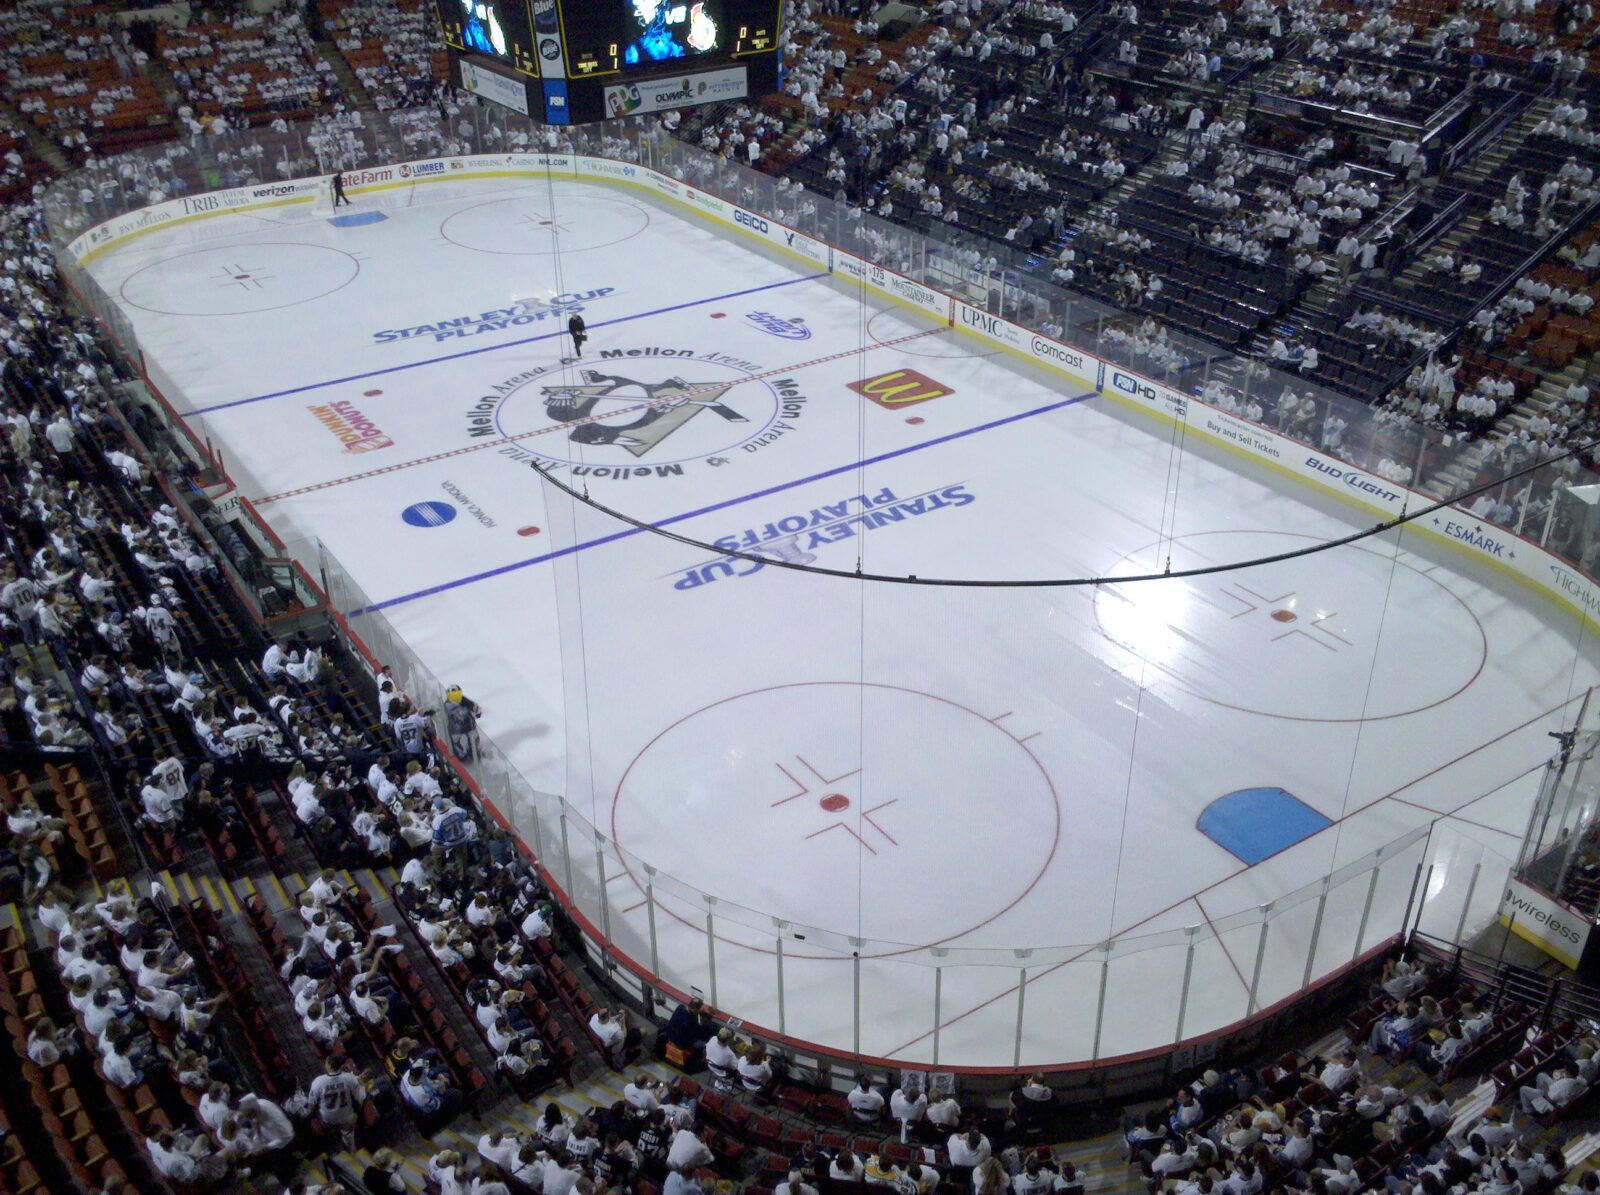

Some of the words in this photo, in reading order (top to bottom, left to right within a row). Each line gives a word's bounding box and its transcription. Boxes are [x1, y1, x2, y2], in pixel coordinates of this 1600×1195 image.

[656, 90, 694, 103] OLYMPIC
[361, 169, 393, 184] Farm
[412, 162, 445, 174] LUMBER
[183, 197, 219, 215] TRIB
[253, 185, 295, 197] verizon
[734, 209, 769, 234] GEICO
[373, 306, 518, 344] STANLEY
[549, 287, 616, 306] CUP
[434, 304, 586, 343] PLAYOFFS
[962, 306, 1003, 337] UPMC
[600, 347, 695, 360] Mellon
[697, 350, 764, 372] Arena
[466, 394, 501, 439] Mellon
[490, 365, 547, 395] Arena
[770, 378, 812, 420] Mellon
[1138, 383, 1156, 400] HD
[740, 424, 797, 454] Arena
[1207, 421, 1221, 434] Buy
[1223, 429, 1237, 439] and
[1239, 434, 1252, 446] Sell
[1254, 440, 1280, 458] Tickets
[572, 463, 685, 481] Mellon
[1305, 457, 1342, 479] BUD
[1350, 475, 1401, 502] LIGHT
[713, 487, 899, 553] PLAYOFFS
[808, 484, 976, 551] STANLEY
[1444, 522, 1505, 557] ESMARK
[673, 552, 768, 591] CUP
[1512, 894, 1581, 944] wireless
